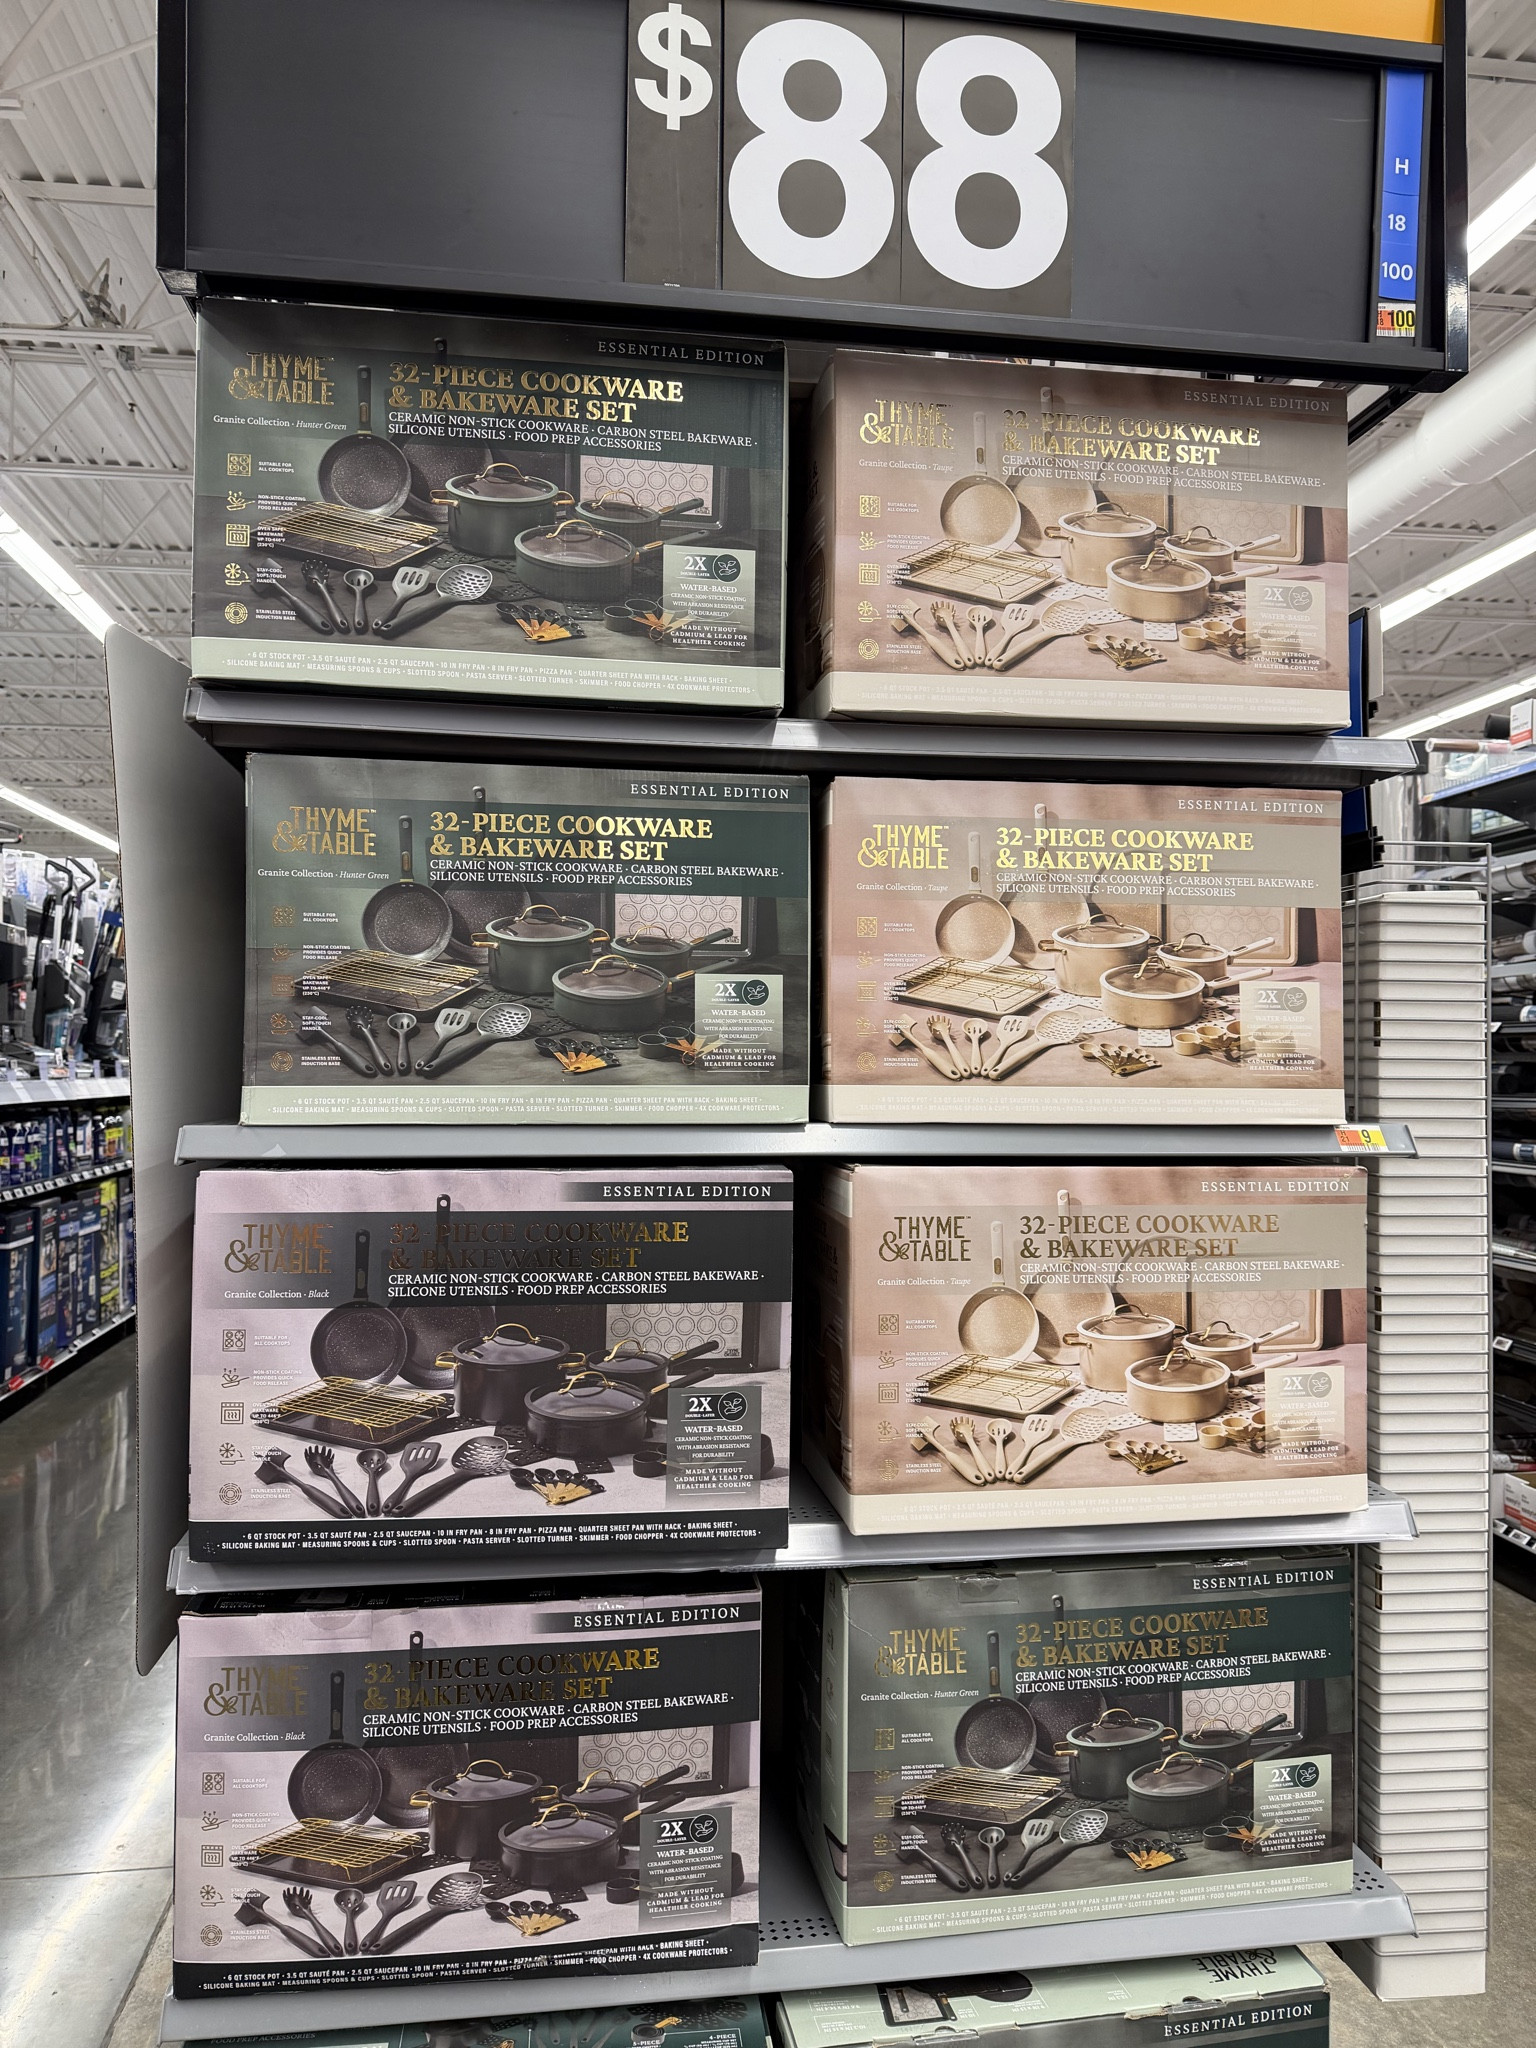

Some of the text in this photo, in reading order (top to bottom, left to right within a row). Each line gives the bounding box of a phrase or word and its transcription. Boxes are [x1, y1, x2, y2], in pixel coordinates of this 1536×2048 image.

[1394, 158, 1409, 176] H
[1387, 213, 1406, 232] 18
[1381, 262, 1413, 281] 100
[1387, 309, 1415, 328] 100
[598, 340, 763, 365] ESSENTIAL EDITION
[389, 360, 684, 403] 32-PIECE COOKWARE
[389, 385, 636, 424] & BAKEWARE SET
[1184, 390, 1329, 411] ESSENTIAL EDITION
[213, 413, 346, 430] Granite Collection Hunter Green
[859, 457, 953, 472] Granite Collection Taupe
[630, 783, 788, 798] ESSENTIAL EDITION
[1178, 799, 1323, 813] ESSENTIAL EDITION
[289, 806, 369, 832] THYME
[430, 810, 713, 839] 32-PIECE COOKWARE
[872, 824, 942, 847] THYME
[997, 826, 1254, 852] 32-PIECE COOKWARE
[430, 834, 668, 861] & BAKEWARE SET
[431, 858, 778, 877] CERAMIC NON-STICK COOKWARE CARBON STEEL BAKEWARE
[997, 848, 1213, 873] & BAKEWARE SET
[257, 868, 389, 879] Granite Collection Hunter Green
[430, 870, 692, 886] SILICONE UTENSILS FOOD PREP ACCESSORIES
[857, 882, 948, 892] Granite Collection Taupe
[714, 983, 736, 997] 2X
[1361, 1129, 1372, 1144] 9
[603, 1185, 771, 1196] ESSENTIAL EDITION
[1202, 1181, 1349, 1191] ESSENTIAL EDITION
[894, 1216, 965, 1238] THYME
[1019, 1213, 1279, 1235] 32-PIECE COOKWARE
[1019, 1237, 1238, 1259] & BAKEWARE SET
[390, 1270, 758, 1284] CERAMIC NON-STICK COOKWARE CARBON STEEL BAKEWARE
[224, 1289, 329, 1299] Granite Collection Black
[389, 1283, 667, 1297] SILICONE UTENSILS FOOD PREP ACCESSORIES
[688, 1397, 712, 1412] 2X
[684, 1425, 743, 1433] WATER-BASED
[1193, 1570, 1334, 1589] ESSENTIAL EDITION
[573, 1607, 740, 1627] ESSENTIAL EDITION
[1016, 1608, 1269, 1644] 32-PIECE COOKWARE
[1016, 1634, 1229, 1668] & BAKEWARE SET
[363, 1649, 660, 1686] 32-PIECE COOKWARE
[393, 1680, 555, 1710] BAKEWARE
[561, 1676, 613, 1700] SET
[860, 1688, 978, 1701] Granite Collection Hunter Green
[203, 1731, 306, 1743] Granite Collection Black
[1271, 1767, 1290, 1782] 2X
[1164, 2004, 1313, 2037] ESSENTIAL EDITION
